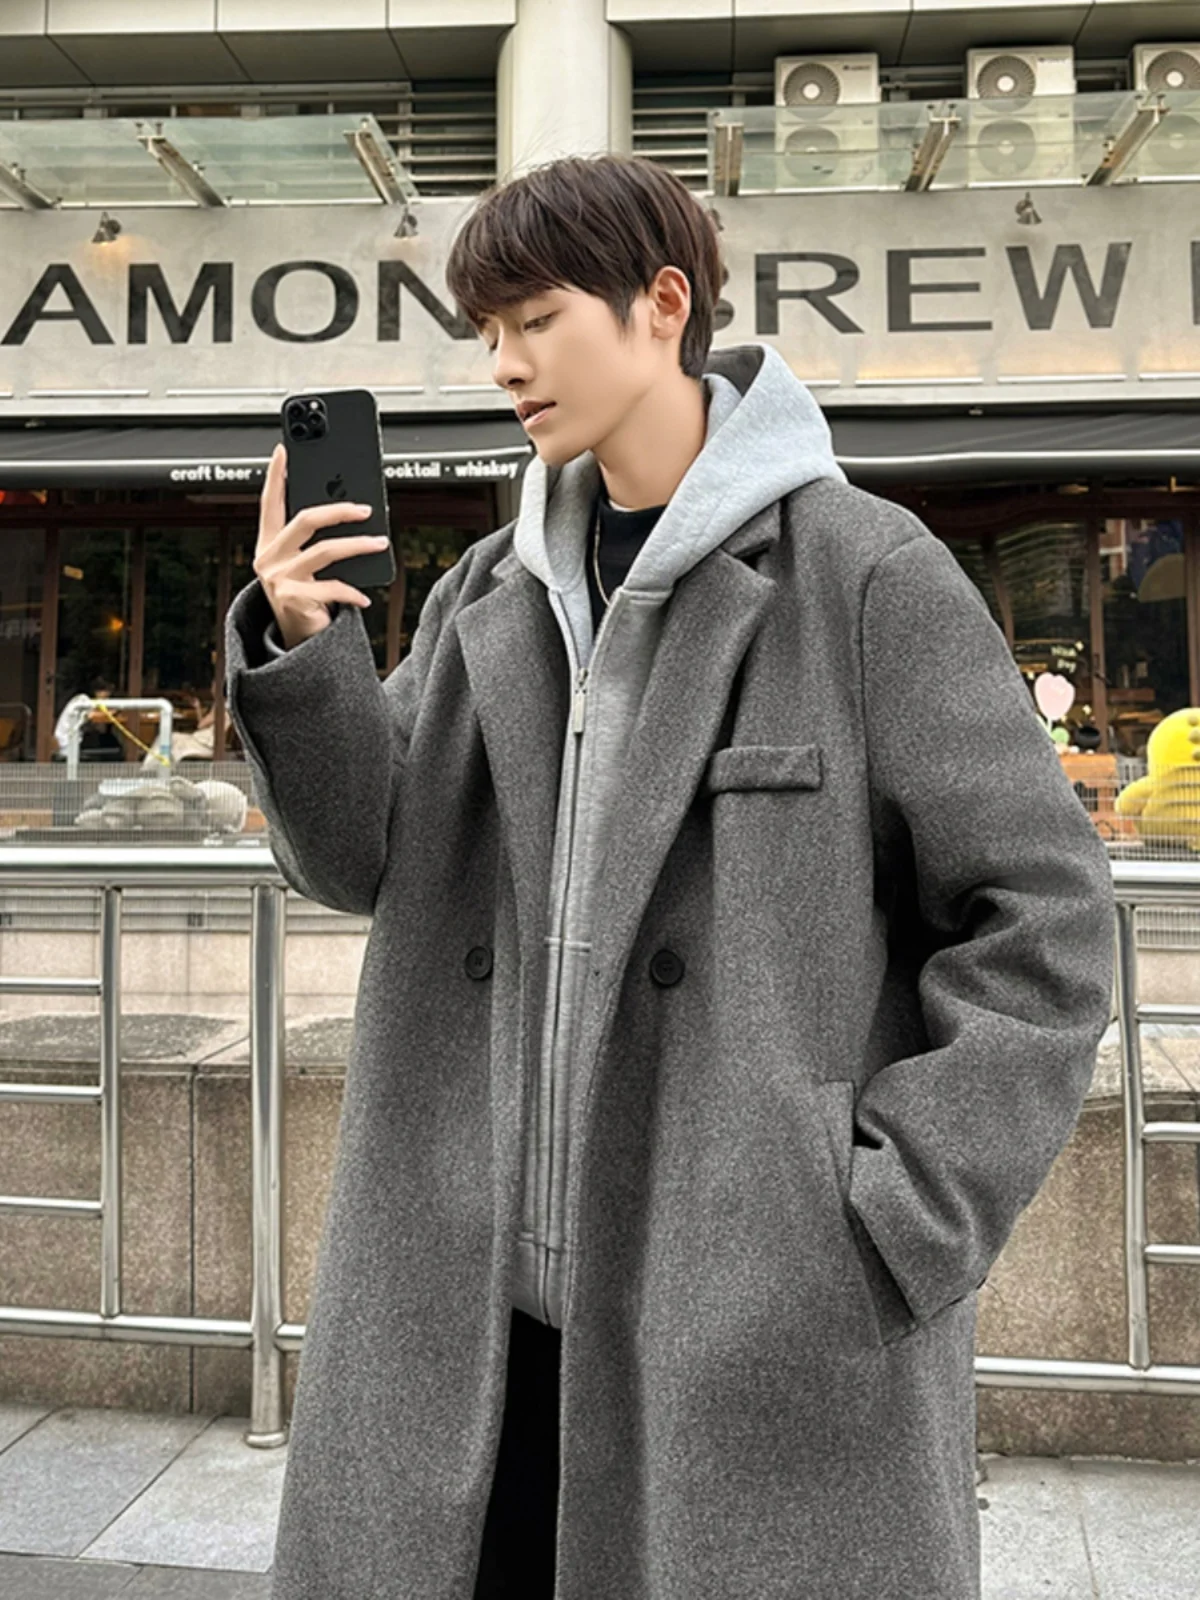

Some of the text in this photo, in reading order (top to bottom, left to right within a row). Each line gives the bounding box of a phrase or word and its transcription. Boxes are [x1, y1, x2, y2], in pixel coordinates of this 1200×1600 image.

[712, 242, 1132, 335] REW
[170, 460, 518, 481] craft beer ocktail whiskey
